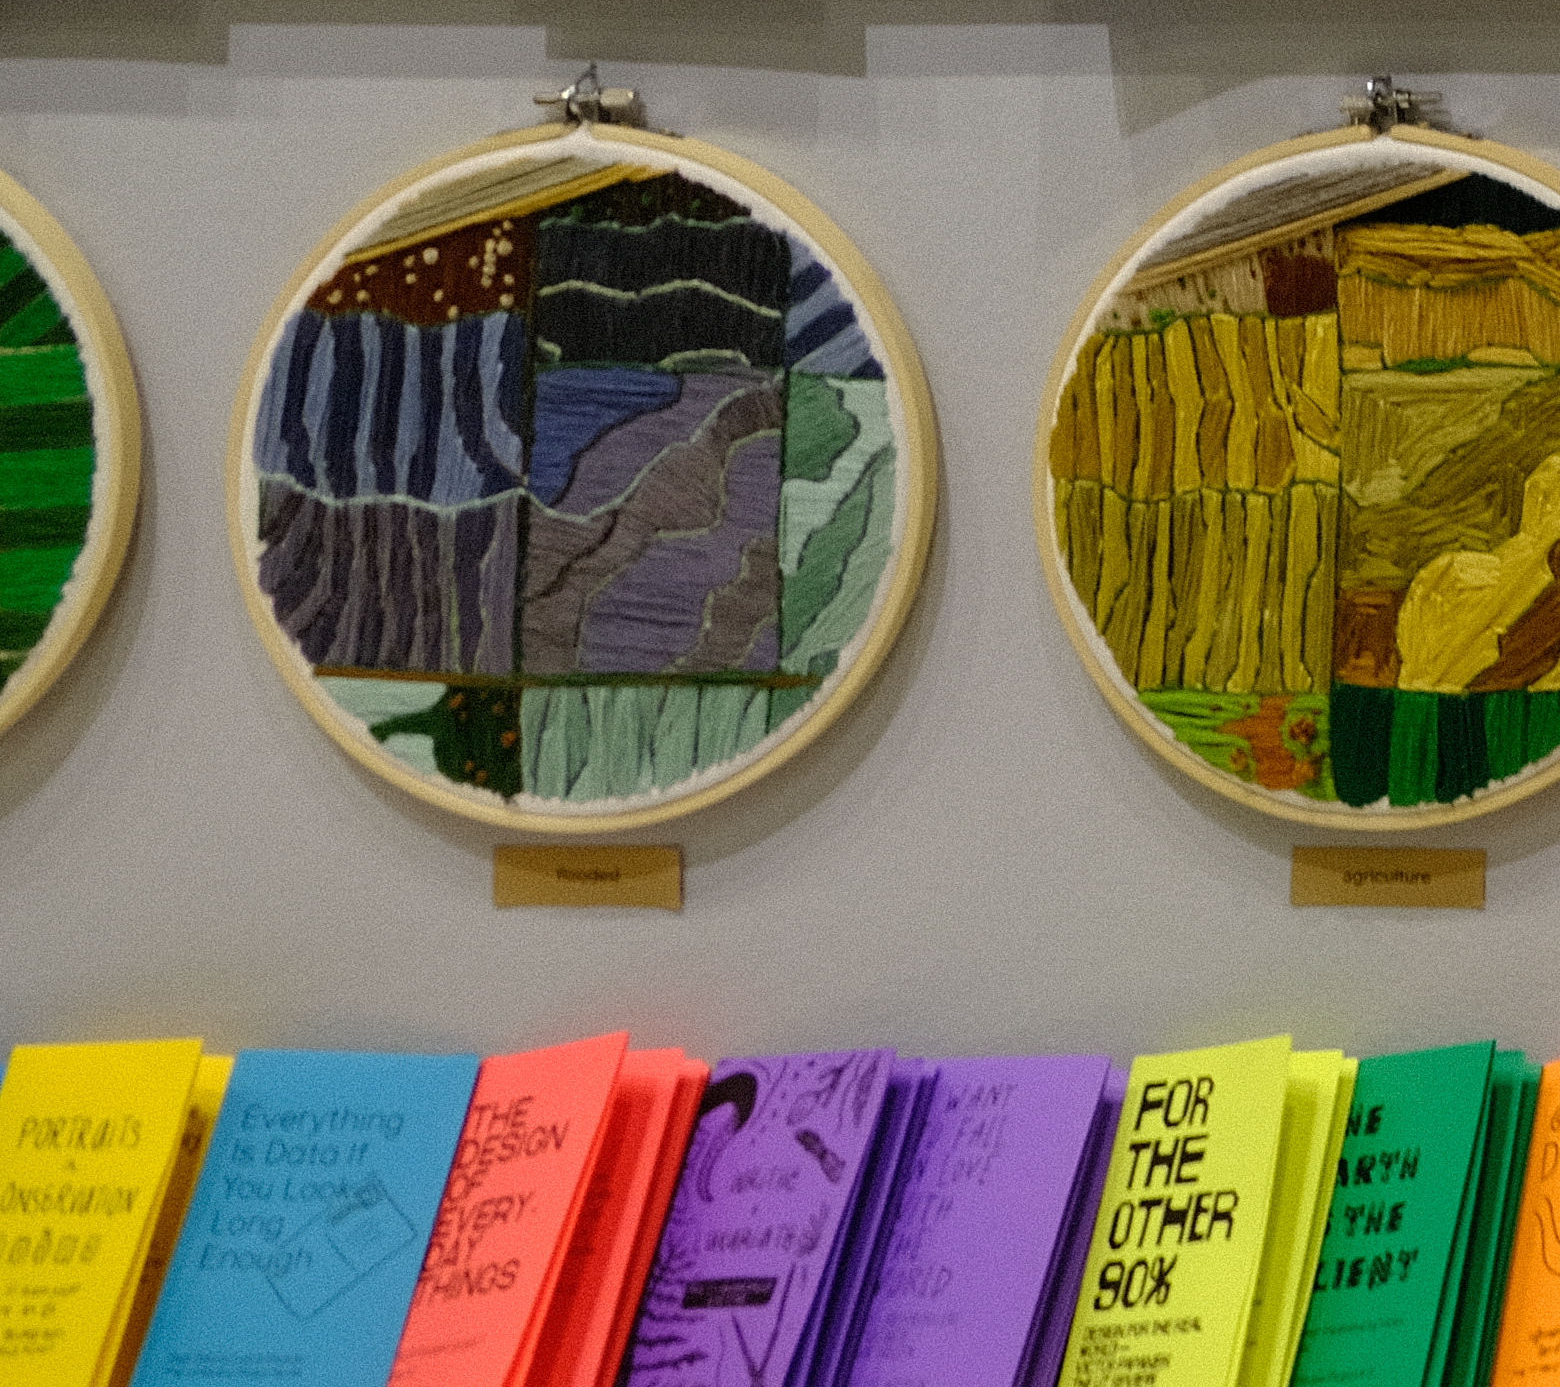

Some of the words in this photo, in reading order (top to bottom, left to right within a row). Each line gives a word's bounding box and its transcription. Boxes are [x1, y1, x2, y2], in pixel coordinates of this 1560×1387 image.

[470, 1097, 533, 1134] THE
[1135, 1076, 1216, 1131] FOR
[457, 1122, 568, 1167] DESIGN
[1126, 1135, 1206, 1191] THE
[1108, 1191, 1239, 1250] OTHER
[1093, 1254, 1179, 1311] 90%
